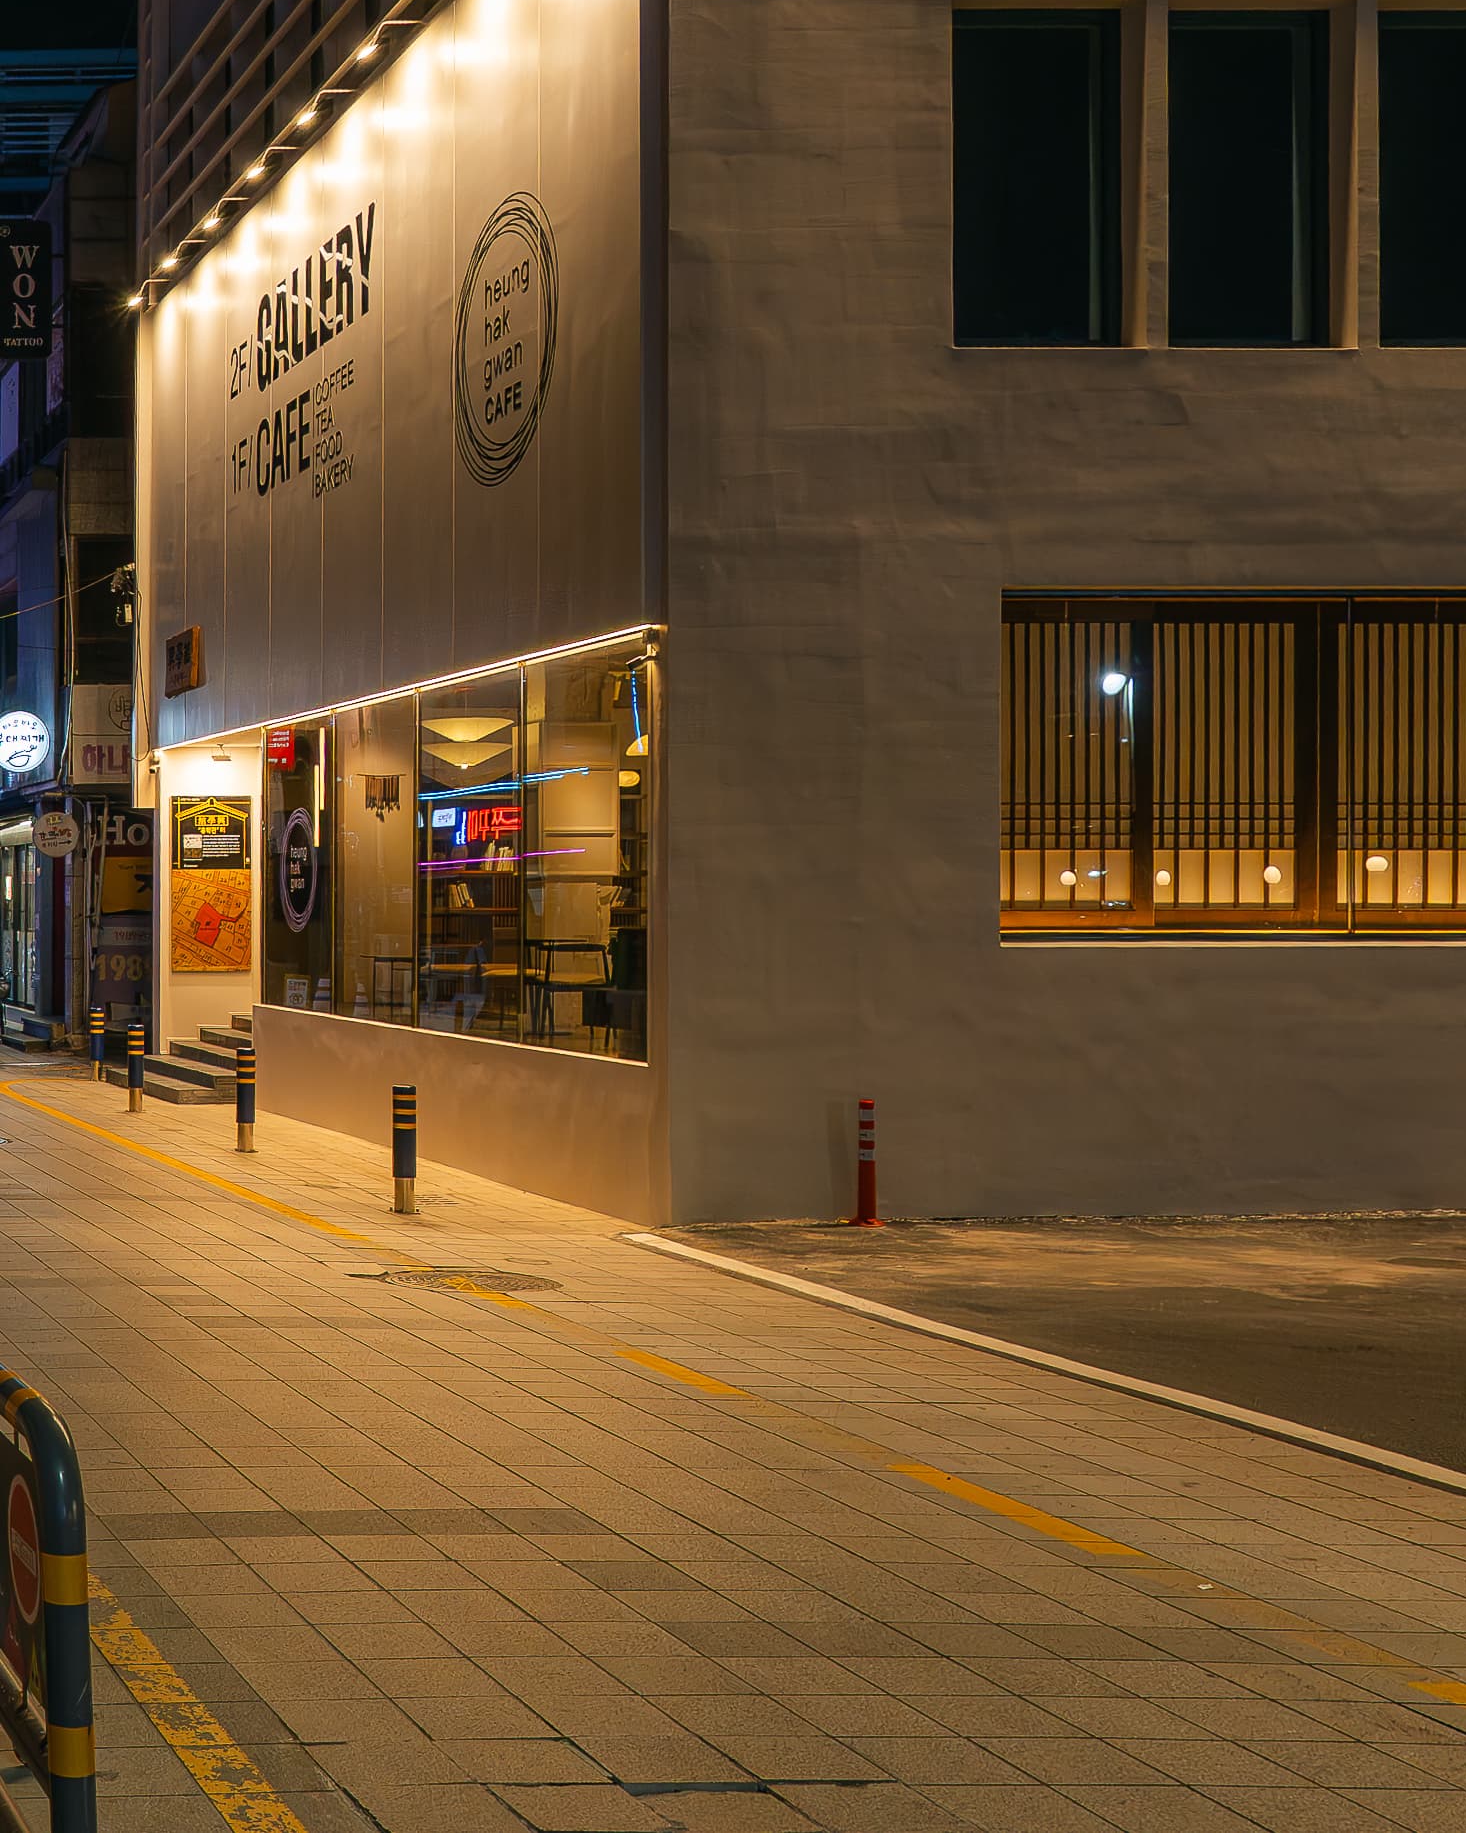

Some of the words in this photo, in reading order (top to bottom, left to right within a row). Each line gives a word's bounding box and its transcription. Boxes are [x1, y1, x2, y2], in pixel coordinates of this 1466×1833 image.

[9, 245, 40, 329] WON
[256, 199, 377, 393] GALLERY
[484, 258, 530, 310] heung
[3, 336, 43, 347] TATTOO
[484, 305, 511, 347] hak
[315, 358, 354, 406] COFFEE
[483, 340, 523, 392] gwan
[316, 405, 335, 437] TEA
[484, 380, 523, 425] CAFE
[256, 389, 311, 497] CAFE
[315, 430, 343, 468] FOOD
[315, 453, 354, 499] BAKERY
